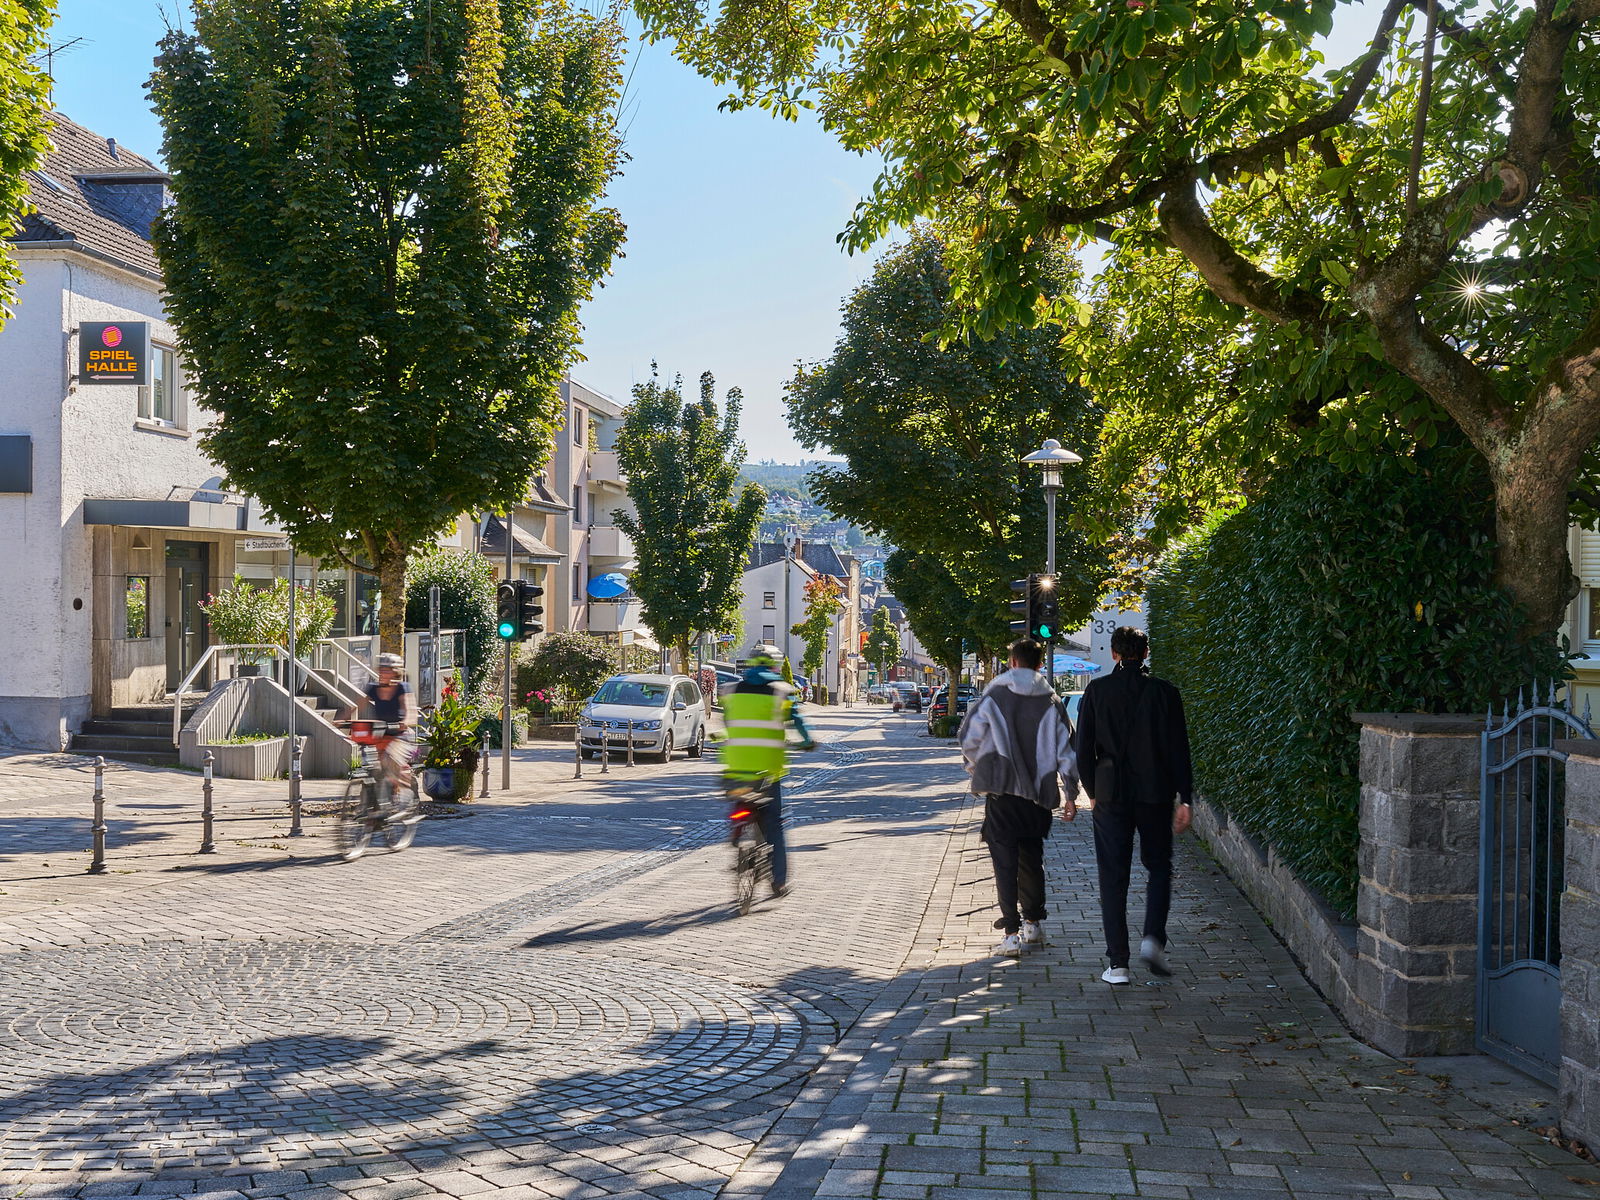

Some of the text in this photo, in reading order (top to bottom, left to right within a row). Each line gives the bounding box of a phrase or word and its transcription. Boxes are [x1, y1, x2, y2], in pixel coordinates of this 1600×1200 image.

[89, 350, 135, 360] SPIEL
[86, 362, 138, 372] HALLE
[1094, 620, 1116, 634] 33
